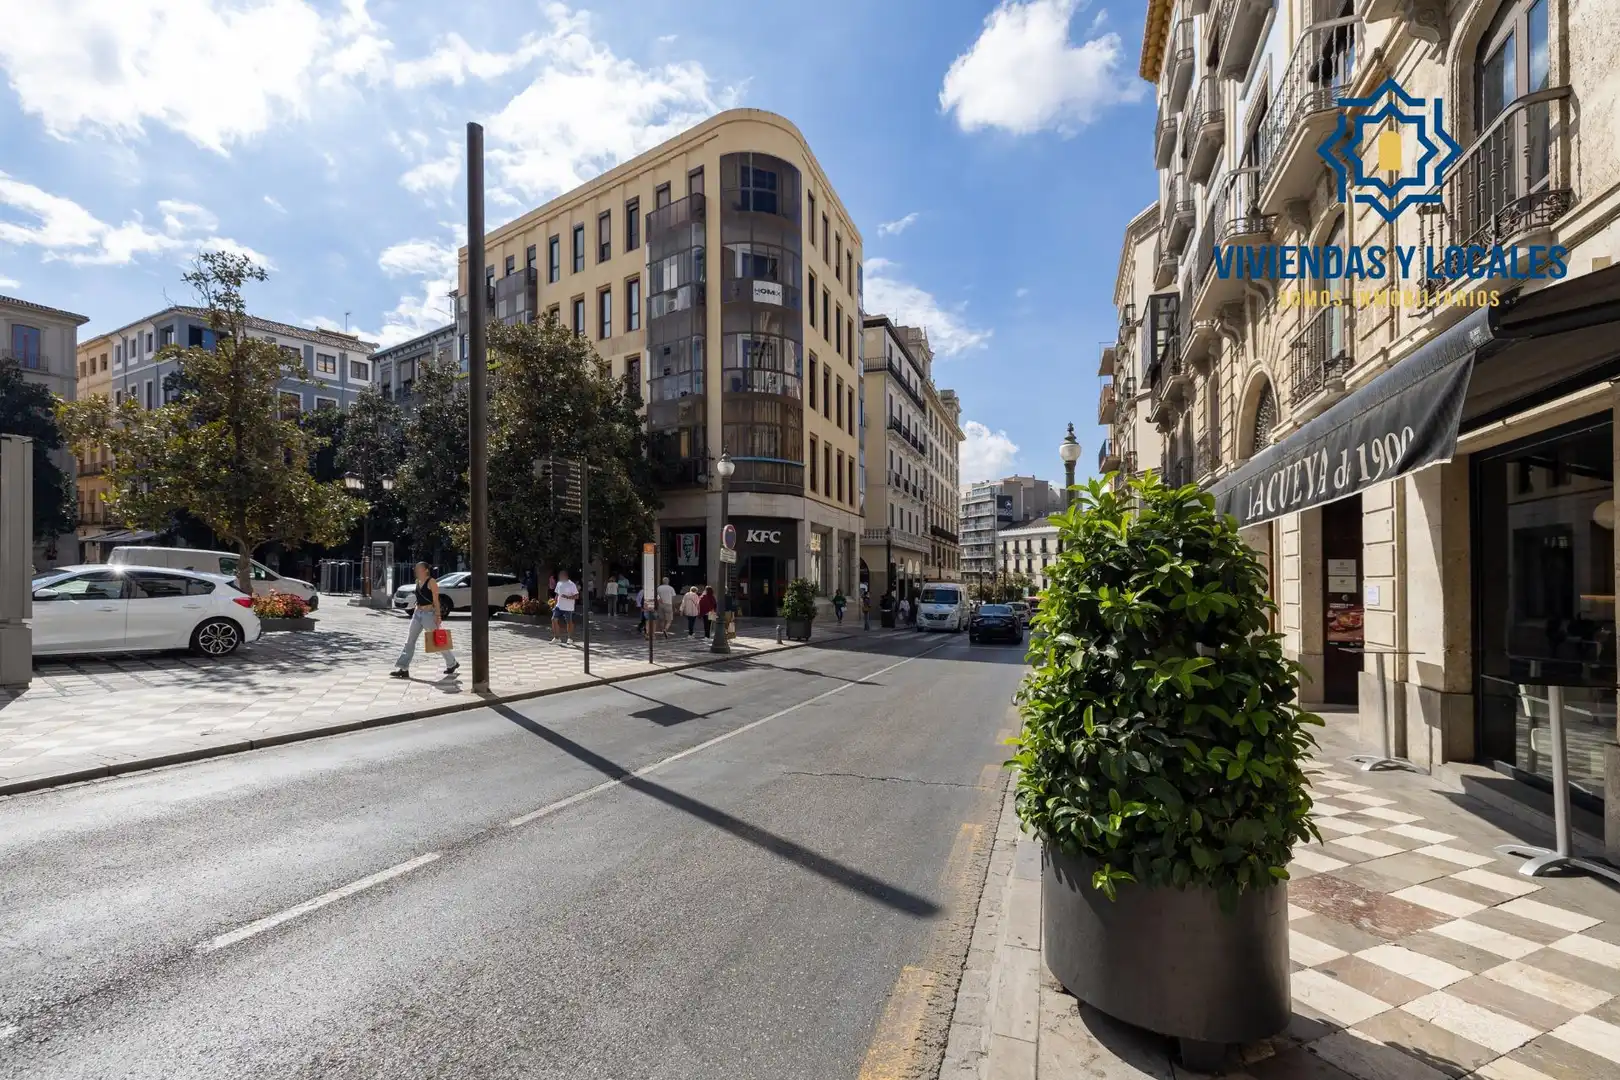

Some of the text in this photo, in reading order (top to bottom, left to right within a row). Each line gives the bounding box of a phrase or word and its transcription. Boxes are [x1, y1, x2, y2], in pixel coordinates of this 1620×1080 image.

[1267, 447, 1328, 512] CUEVA
[1356, 425, 1414, 482] 1900
[745, 529, 781, 544] KFC
